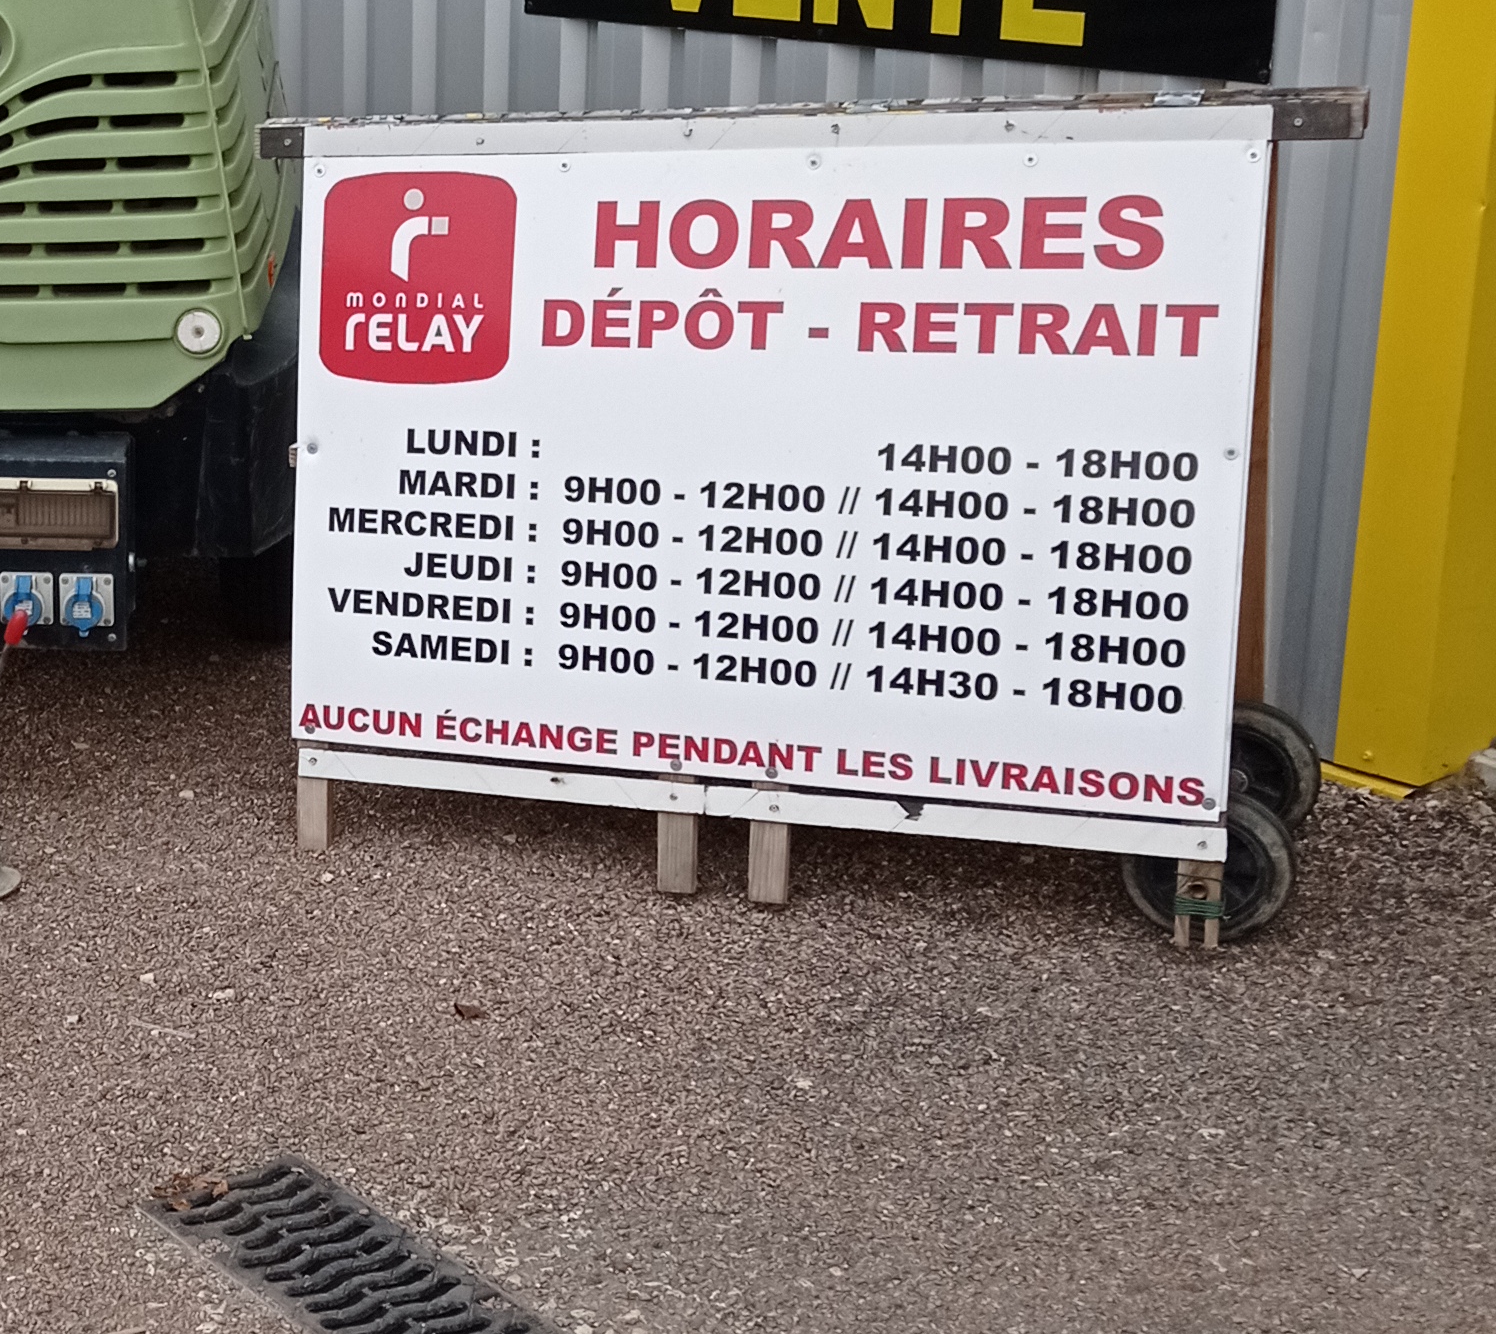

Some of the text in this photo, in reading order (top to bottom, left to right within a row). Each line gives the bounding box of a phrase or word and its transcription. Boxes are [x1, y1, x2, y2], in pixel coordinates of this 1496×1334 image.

[594, 195, 1165, 271] HORAIRES
[541, 287, 784, 351] DÉPÔT
[857, 301, 1220, 357] RETRAIT
[406, 428, 517, 458] LUNDI
[877, 442, 1012, 476] 14H00
[1056, 448, 1199, 482] 18H00
[399, 469, 516, 500] MARDI
[564, 475, 661, 506] 9H00
[700, 481, 825, 513] 12H00
[875, 487, 1009, 521] 14H00
[1053, 494, 1195, 529] 18H00
[328, 506, 514, 541] MERCREDI
[562, 517, 659, 549] 9H00
[698, 524, 823, 557] 12H00
[872, 532, 1006, 566] 14H00
[1050, 540, 1192, 576] 18H00
[403, 551, 513, 583] JEUDI
[561, 559, 658, 591] 9H00
[696, 567, 821, 601] 12H00
[870, 576, 1004, 612] 14H00
[1047, 585, 1189, 622] 18H00
[327, 587, 511, 624] VENDREDI
[559, 601, 656, 634] 9H00
[694, 610, 819, 645] 12H00
[868, 621, 1001, 657] 14H00
[1045, 631, 1186, 668] 18H00
[371, 630, 510, 665] SAMEDI
[558, 643, 655, 676] 9H00
[693, 652, 817, 688] 12H00
[866, 665, 999, 701] 14H30
[1042, 677, 1183, 715] 18H00
[299, 704, 1206, 806] AUCUN ÉCHANGE PENDANT LES LIVRAISONS
